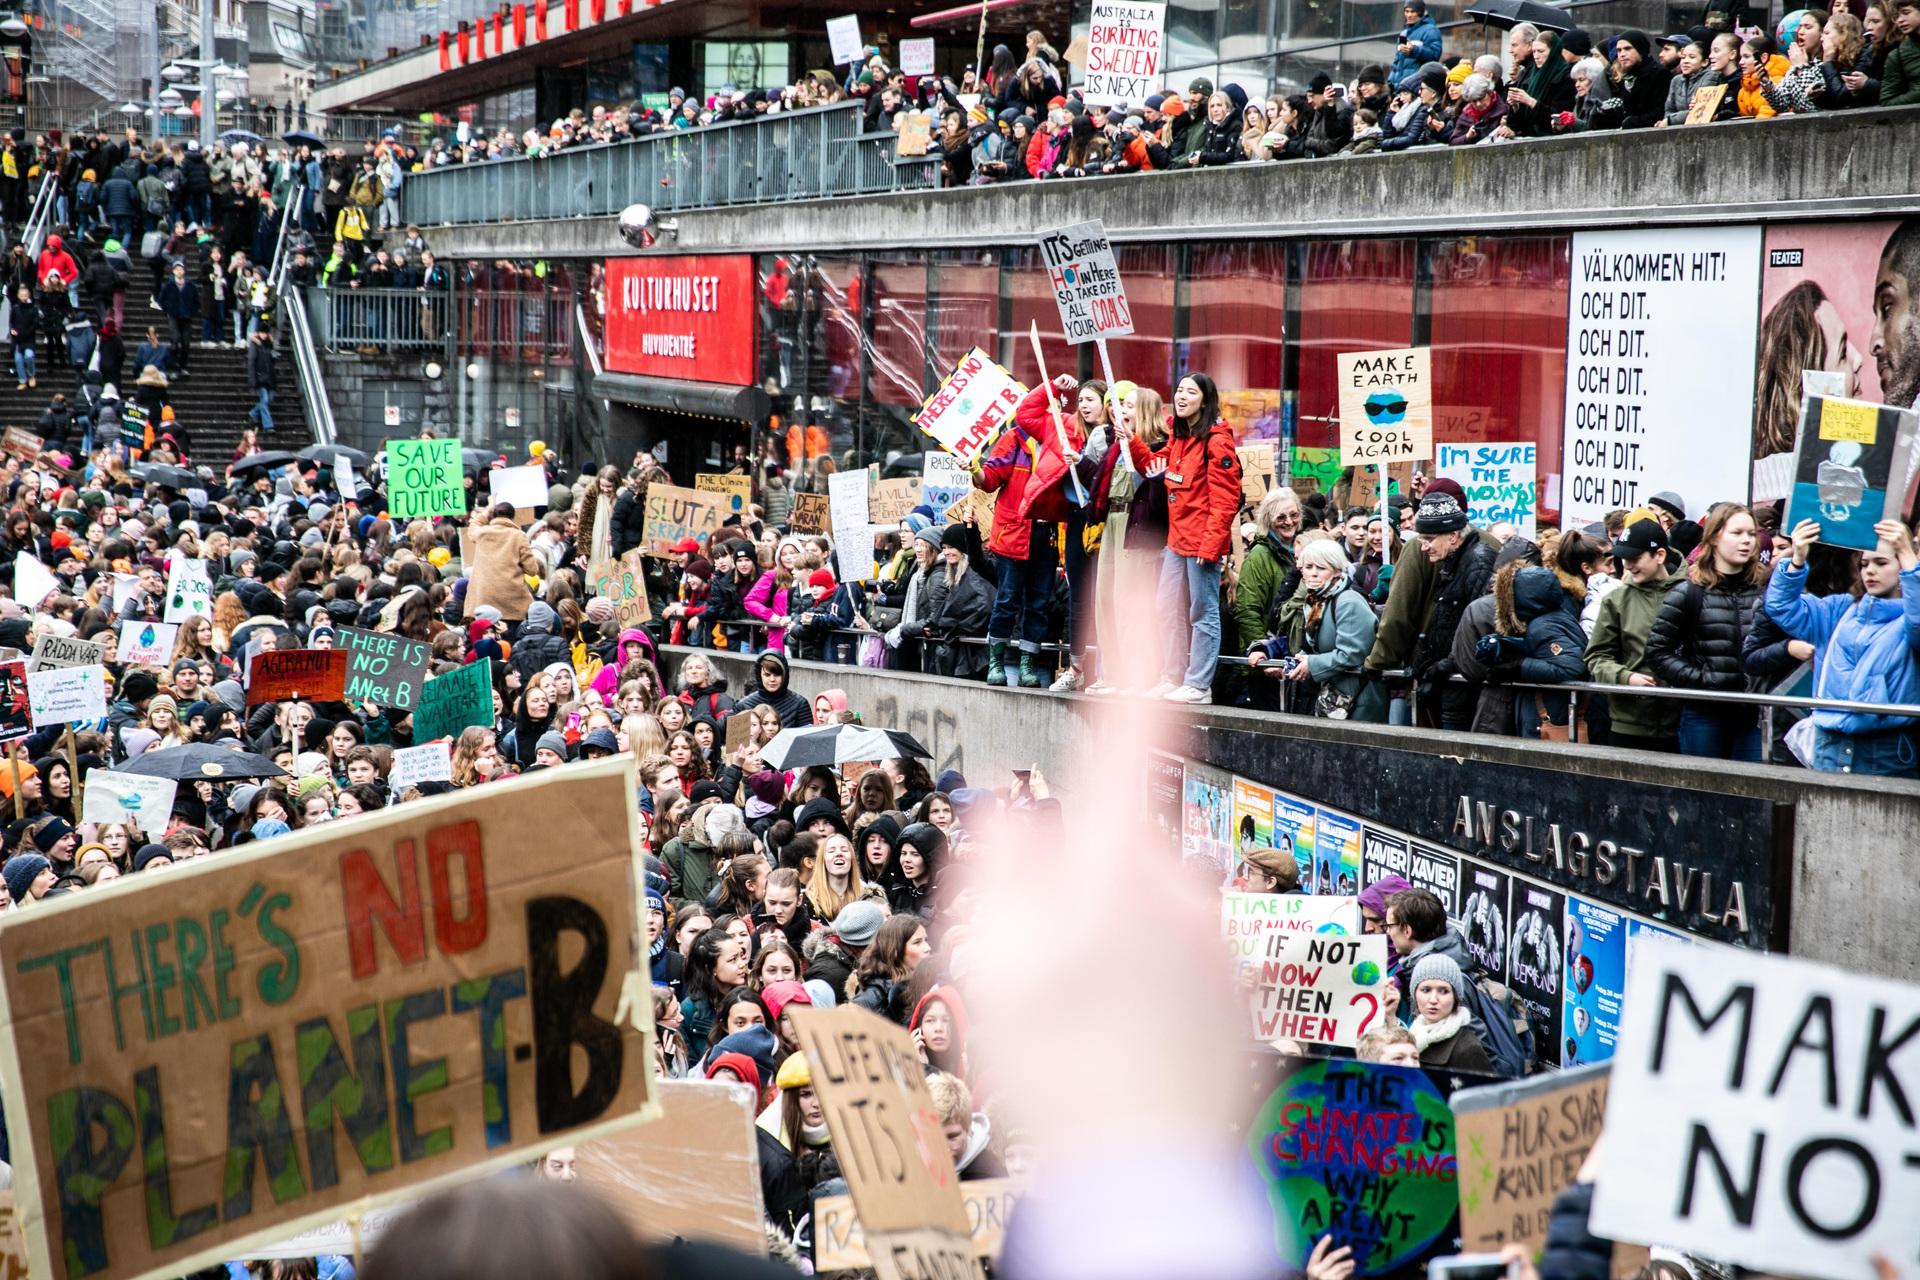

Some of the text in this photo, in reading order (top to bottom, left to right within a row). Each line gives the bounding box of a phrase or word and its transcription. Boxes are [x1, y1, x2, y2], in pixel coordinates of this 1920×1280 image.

[1093, 6, 1154, 20] AUSTRALIA
[1119, 19, 1131, 28] IS
[1091, 26, 1160, 48] BURNING.
[1089, 47, 1157, 76] SWEDEN
[1085, 75, 1150, 98] IS NEXT
[1042, 231, 1108, 266] IT'S GETTING
[1771, 250, 1802, 265] TEATER
[1583, 248, 1726, 282] VÄLKOMMEN HIT!
[623, 275, 720, 312] KULTURHUSET
[1058, 282, 1116, 305] SO TAKE OFF
[1581, 292, 1650, 320] OCH DIT.
[1069, 304, 1087, 319] ALL
[1065, 319, 1098, 338] YOUR
[1579, 329, 1648, 358] OCH DIT.
[1353, 355, 1414, 372] MAKE
[915, 357, 982, 429] THERE IS NO
[1353, 373, 1418, 387] EARTH
[1577, 365, 1647, 396] OCH DIT.
[954, 400, 1006, 458] PLANET
[1000, 388, 1019, 405] B
[1576, 402, 1645, 434] OCH DIT.
[1353, 444, 1413, 457] AGAIN
[1354, 430, 1411, 442] COOL
[396, 442, 453, 467] SAVE
[931, 456, 956, 470] RAISE
[1474, 446, 1535, 466] SURE
[1575, 439, 1643, 472] OCH DIT.
[405, 466, 447, 489] OUR
[700, 475, 714, 484] THE
[1471, 468, 1511, 482] THE
[394, 488, 461, 516] FUTURE
[1573, 475, 1642, 508] OCH DIT.
[41, 638, 100, 665] RÄDDA VÅR
[337, 629, 425, 667] THERE IS
[352, 652, 389, 676] NO
[395, 681, 412, 707] B
[1365, 838, 1407, 873] XAVIER
[1452, 795, 1749, 932] ANSLAGSTAVLA
[1410, 855, 1455, 891] XAVIER
[1226, 896, 1303, 916] TIME IS
[17, 818, 488, 1065] THERE'S NO
[1265, 934, 1361, 965] IF NOT
[1261, 960, 1322, 988] NOW
[1259, 985, 1333, 1014] THEN
[1257, 1010, 1338, 1042] WHEN
[1325, 1072, 1405, 1110] THE
[1279, 1102, 1449, 1151] CLIMATE IS
[1501, 1105, 1556, 1159] HUR
[1272, 1131, 1457, 1183] CHANGING
[1323, 1167, 1400, 1211] WHY
[1493, 1159, 1544, 1203] KAN
[1676, 1120, 1920, 1243] NO
